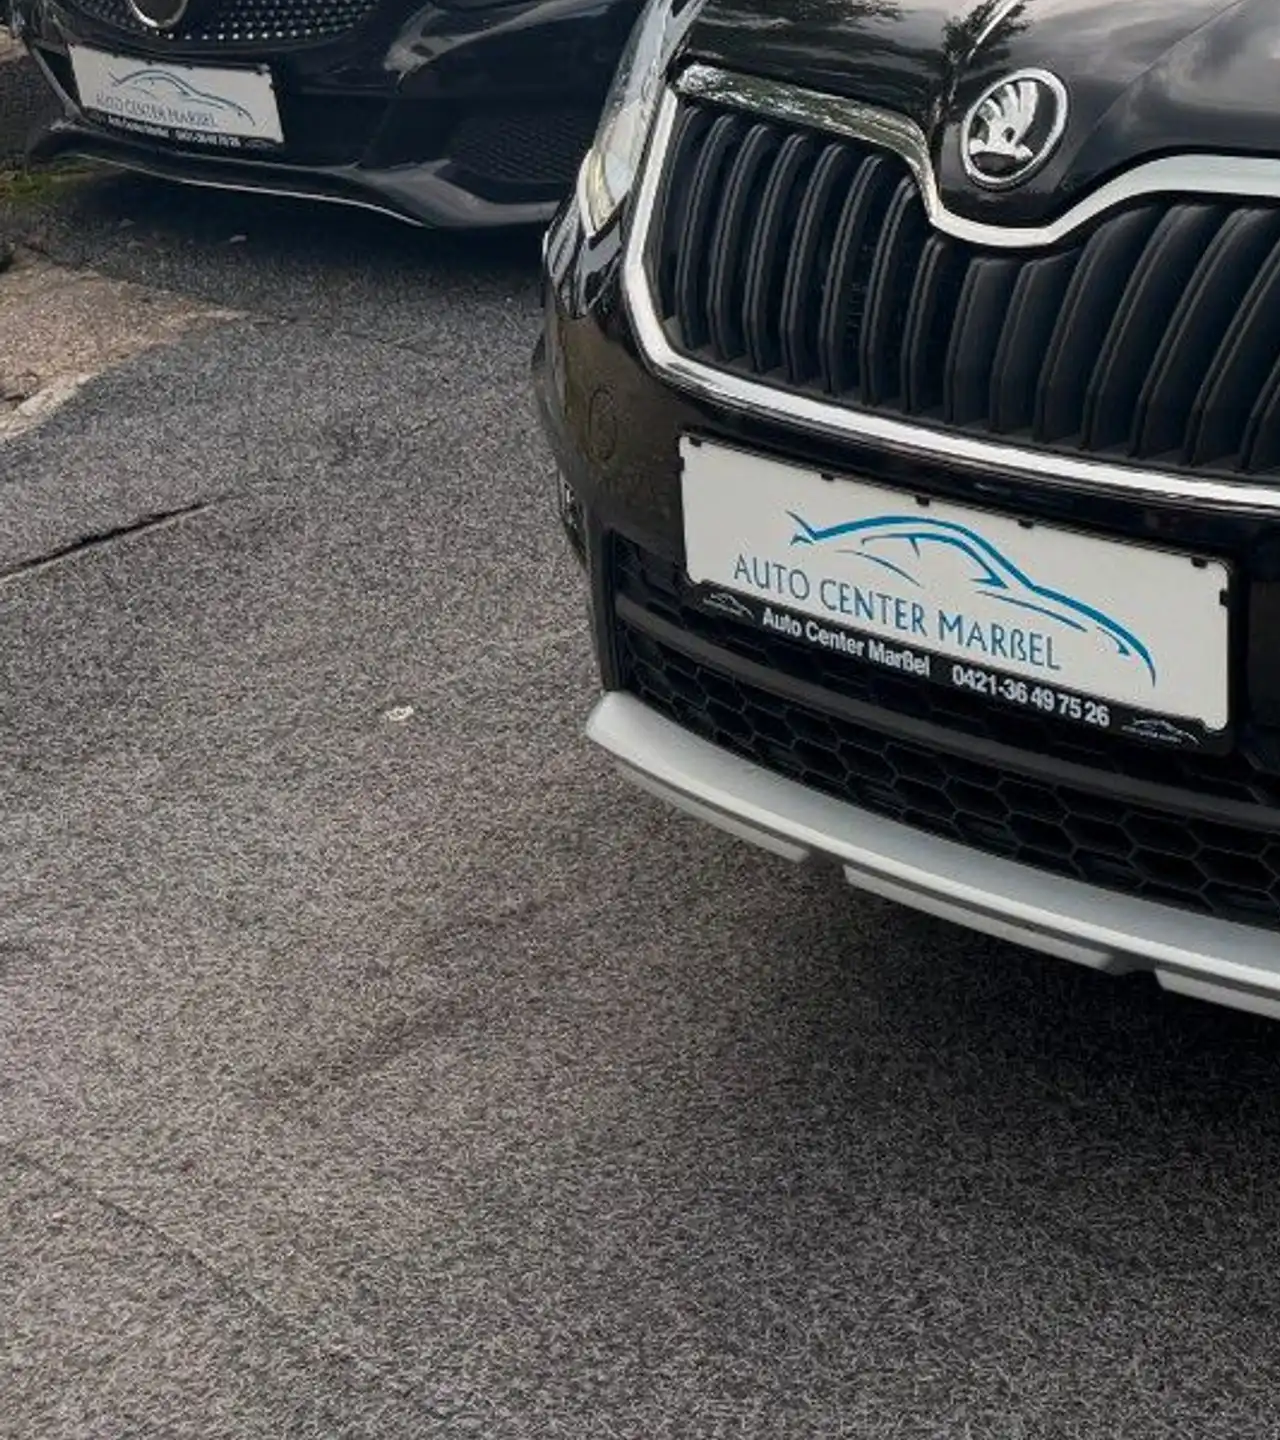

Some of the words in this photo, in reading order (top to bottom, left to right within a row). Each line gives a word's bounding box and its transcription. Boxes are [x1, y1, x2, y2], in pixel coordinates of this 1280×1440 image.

[733, 553, 810, 602] AUTO
[820, 578, 928, 638] CENTER
[937, 609, 1063, 671] MARßEL
[761, 606, 802, 638] Auto
[805, 621, 866, 657] Center
[951, 665, 1029, 704] 0421-36
[1029, 687, 1055, 712] 49
[1057, 693, 1083, 720] 75
[1084, 702, 1111, 728] 26
